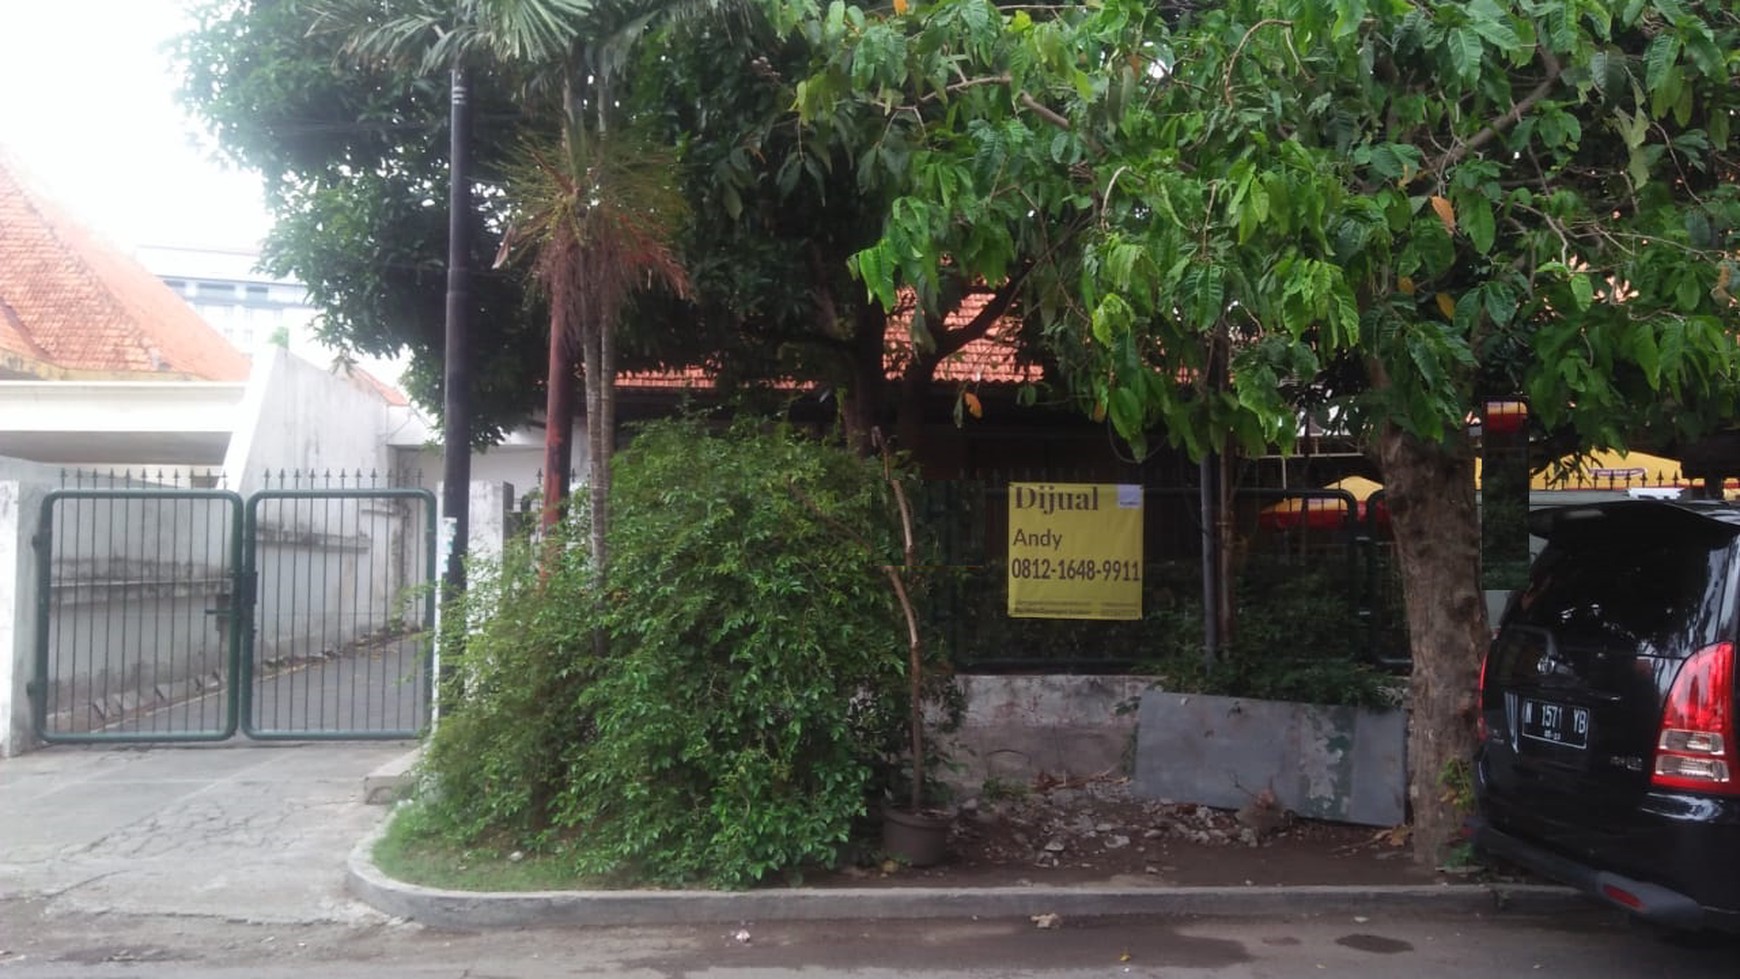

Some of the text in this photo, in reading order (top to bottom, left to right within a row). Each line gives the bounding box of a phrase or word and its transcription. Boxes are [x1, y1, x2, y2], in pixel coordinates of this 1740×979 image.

[1015, 485, 1099, 515] Dijual
[1013, 528, 1063, 551] Andy
[1012, 558, 1141, 581] 0812-1648-9911
[1542, 704, 1563, 729] 1571
[1573, 708, 1587, 734] YB
